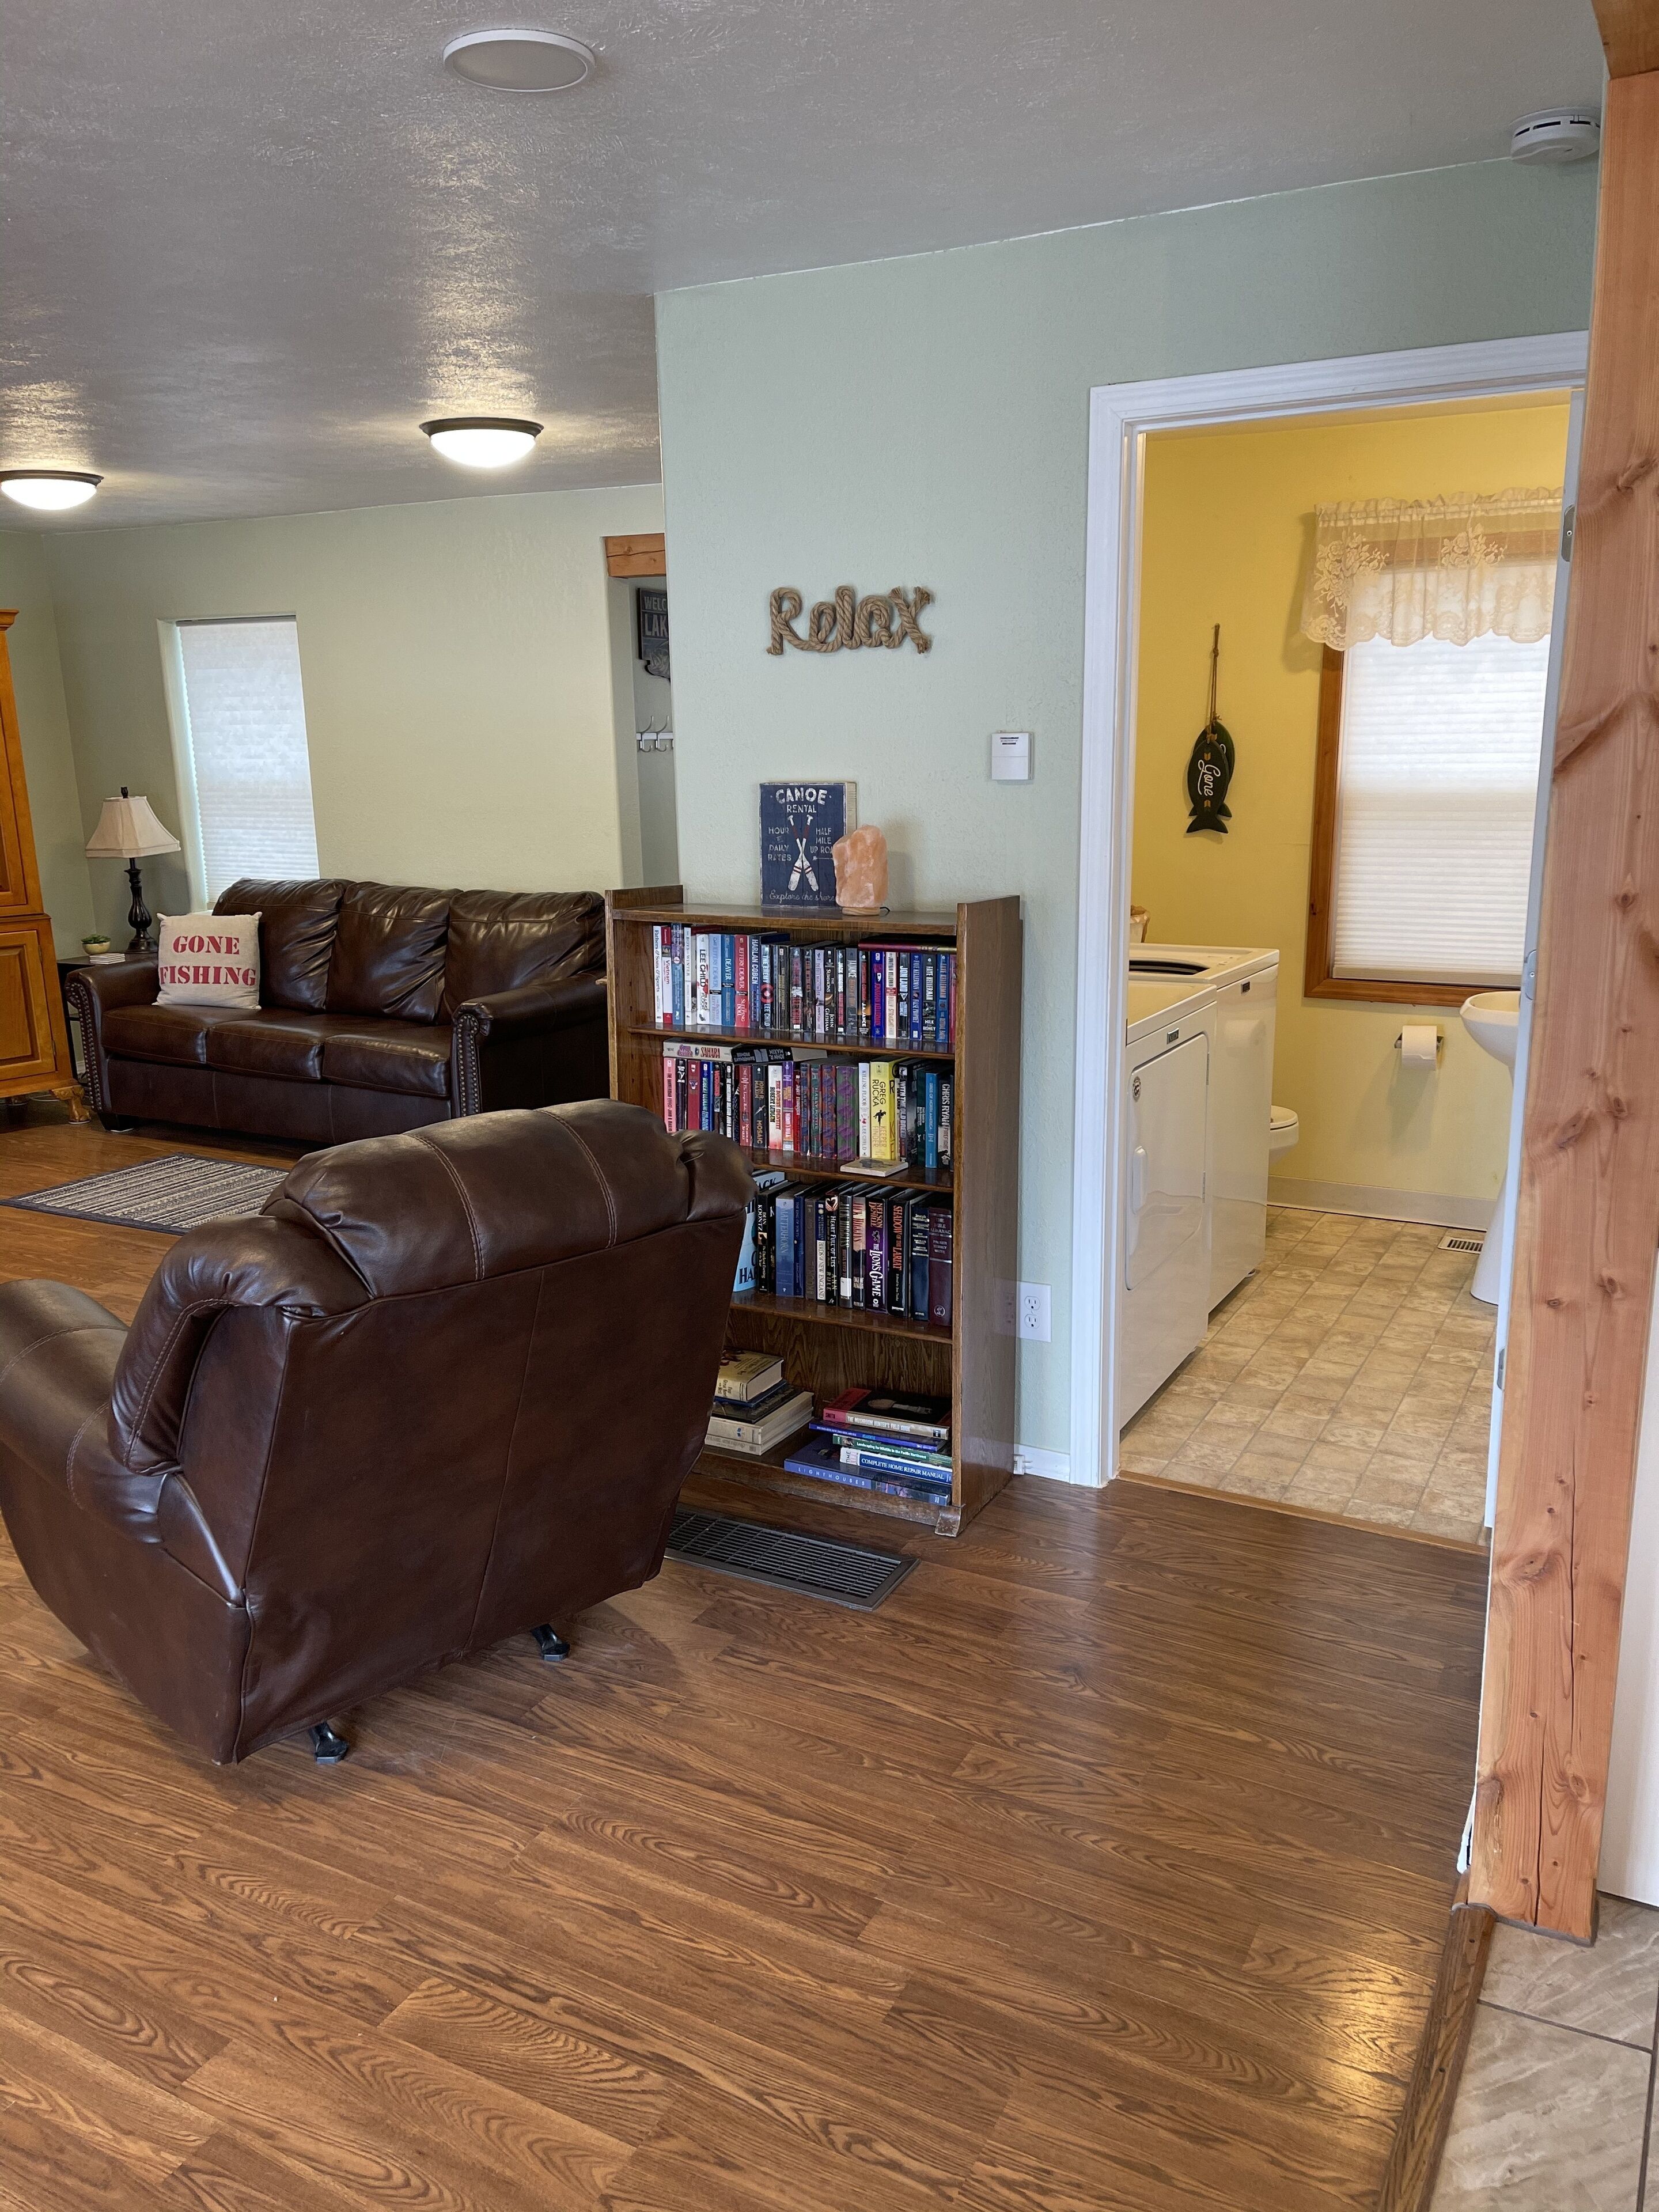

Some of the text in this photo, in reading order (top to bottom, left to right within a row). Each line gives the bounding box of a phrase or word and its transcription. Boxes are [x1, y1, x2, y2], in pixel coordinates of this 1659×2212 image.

[645, 596, 667, 611] WELC
[645, 613, 668, 637] LAK
[766, 585, 930, 655] Relax
[1198, 759, 1221, 797] Gone
[775, 787, 828, 805] CANOE
[787, 805, 817, 813] RENTAL
[810, 846, 818, 854] UP
[770, 889, 800, 903] Explore
[802, 891, 813, 900] the
[173, 935, 240, 955] GONE
[160, 965, 256, 986] FISHING
[900, 965, 908, 992] JON LAND
[700, 1047, 721, 1058] SAHARA
[942, 1084, 950, 1125] CHRIS RYAN
[839, 1202, 850, 1248] JACK HIGGINS
[853, 1203, 864, 1243] JACK HIGGINS
[869, 1202, 877, 1228] DEMILLE
[893, 1205, 902, 1234] SHADOW
[780, 1207, 789, 1254] MATTERHORN
[869, 1249, 883, 1271] LION'S
[893, 1246, 902, 1271] LARIAT
[869, 1271, 883, 1297] GAME
[854, 1417, 873, 1426] MUSHROOM
[900, 1424, 911, 1432] GUIDE
[857, 1442, 876, 1450] Landscaping
[797, 1467, 865, 1486] LIGHTHOUSES
[861, 1459, 888, 1468] COMPLETE
[904, 1467, 922, 1475] REPAIR
[922, 1470, 945, 1479] MANUAL
